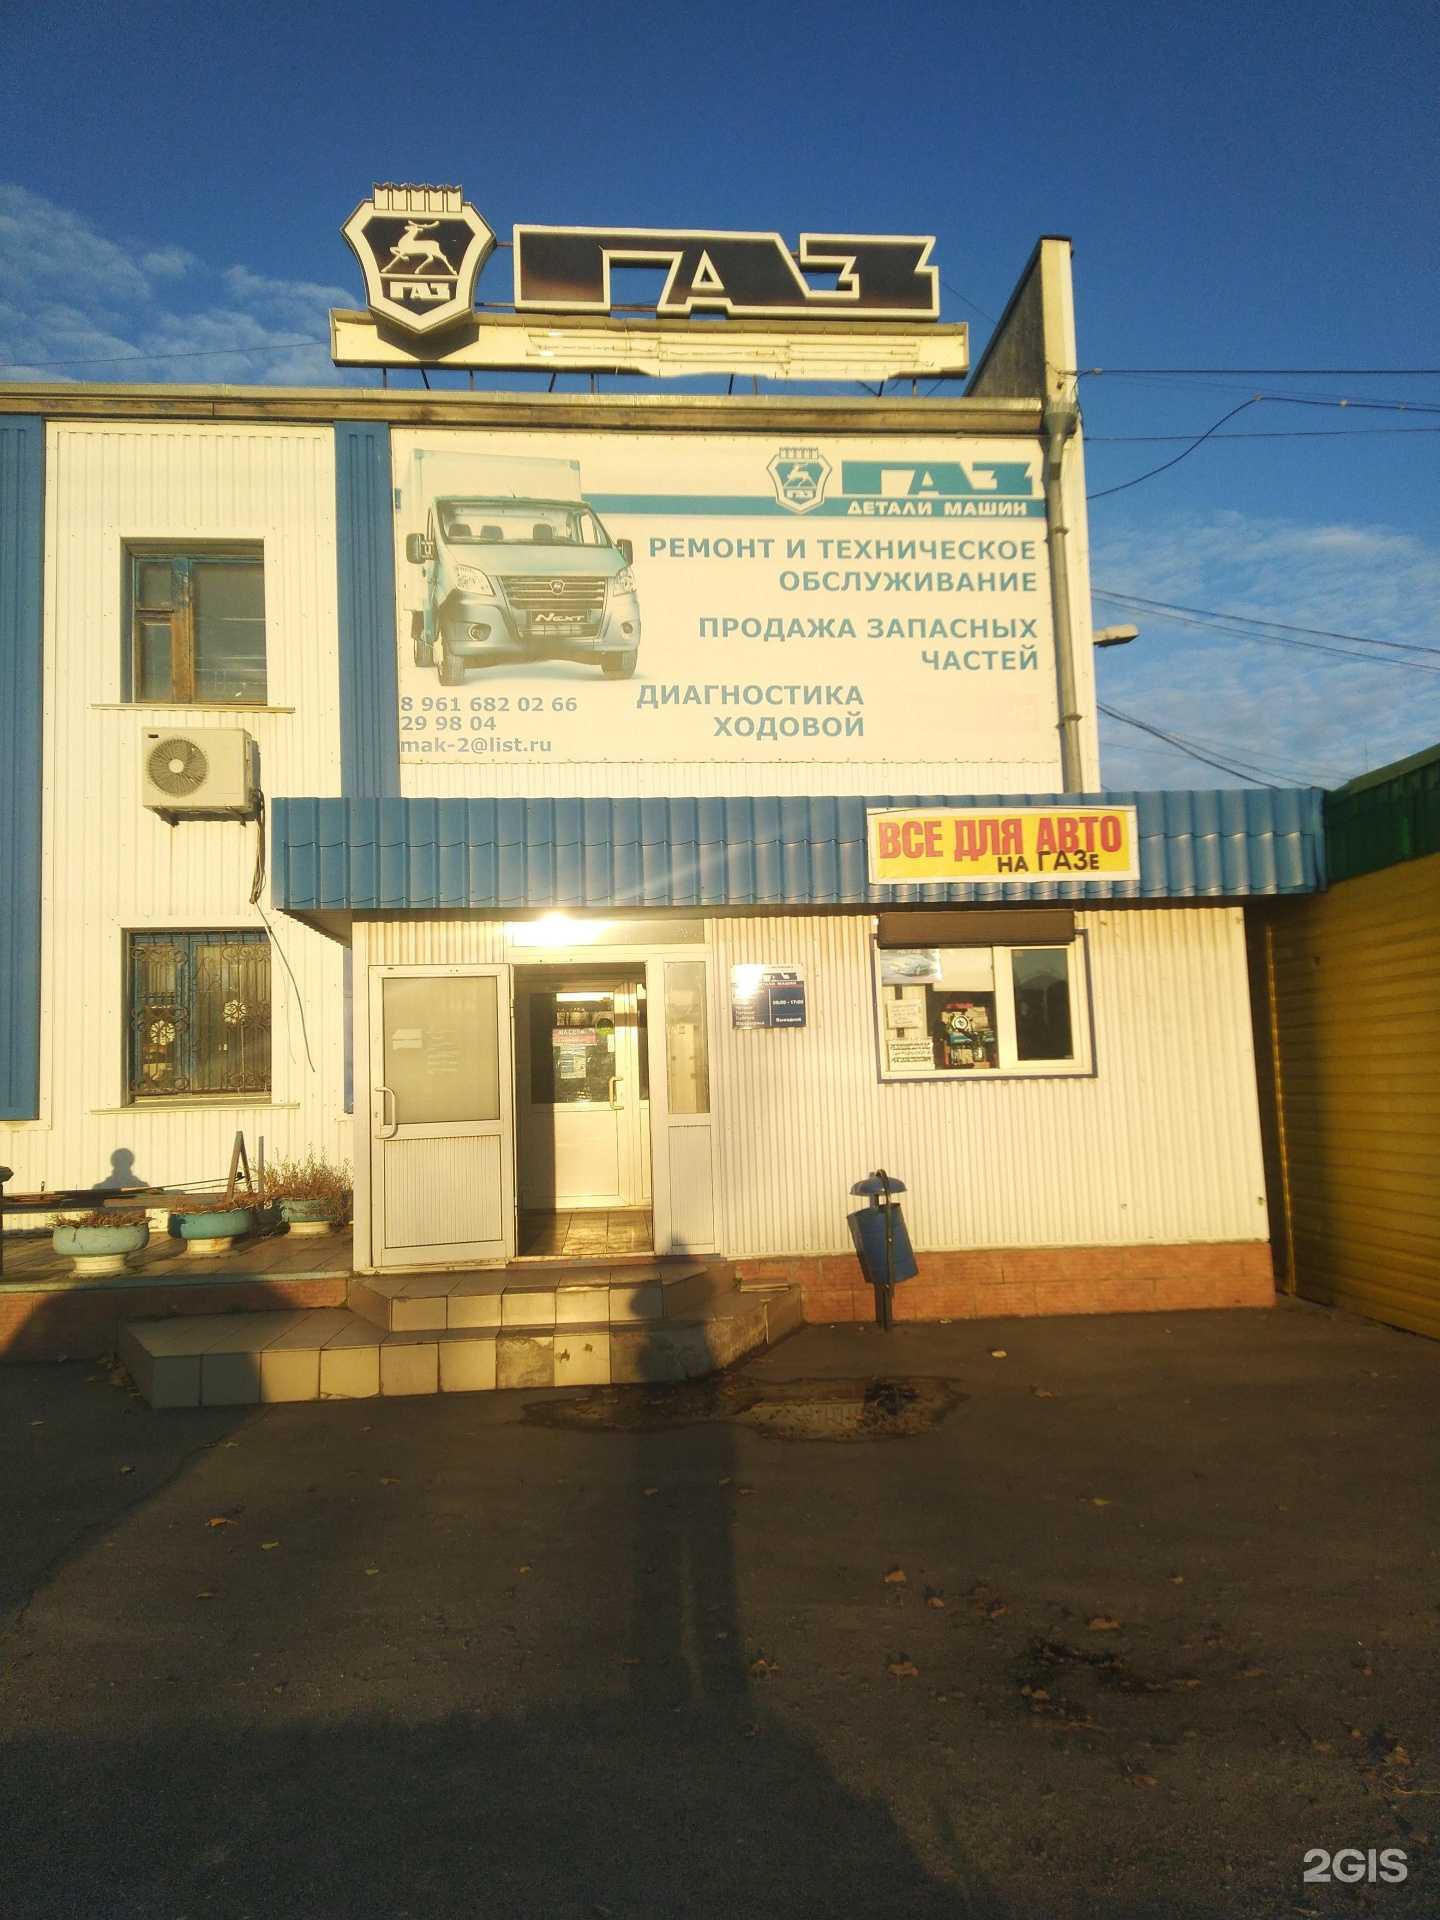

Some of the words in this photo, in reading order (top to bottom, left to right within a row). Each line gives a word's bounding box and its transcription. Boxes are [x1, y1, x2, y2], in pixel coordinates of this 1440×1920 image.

[513, 224, 940, 320] ГАЗ
[389, 281, 450, 300] ГАЗ
[841, 461, 1033, 496] ГАЗ
[847, 501, 932, 516] ДЕТАЛИ
[944, 502, 1027, 516] МАШИН
[649, 538, 775, 559] РЕМОНТ
[786, 540, 806, 560] И
[816, 539, 1036, 561] ТЕХНИЧЕСКОЕ
[779, 571, 1038, 592] ОБСЛУЖИВАНИЕ
[699, 617, 856, 642] ПРОДАЖА
[867, 617, 1038, 639] ЗАПАСНЫХ
[921, 644, 1039, 670] ЧАСТЕЙ
[400, 696, 413, 712] 8
[421, 696, 462, 712] 961
[470, 696, 510, 712] 682
[518, 696, 544, 712] 02
[551, 696, 578, 712] 66
[636, 684, 865, 709] ДИАГНОСТИКА
[400, 715, 427, 731] 29
[435, 715, 462, 731] 98
[470, 715, 497, 731] 04
[713, 711, 865, 741] ХОДОВОЙ
[400, 736, 552, 754] mak-2@list.ru
[878, 820, 944, 859] ВСЕ
[954, 818, 1024, 862] ДЛЯ
[1035, 815, 1123, 854] АВТО
[997, 856, 1030, 873] НА
